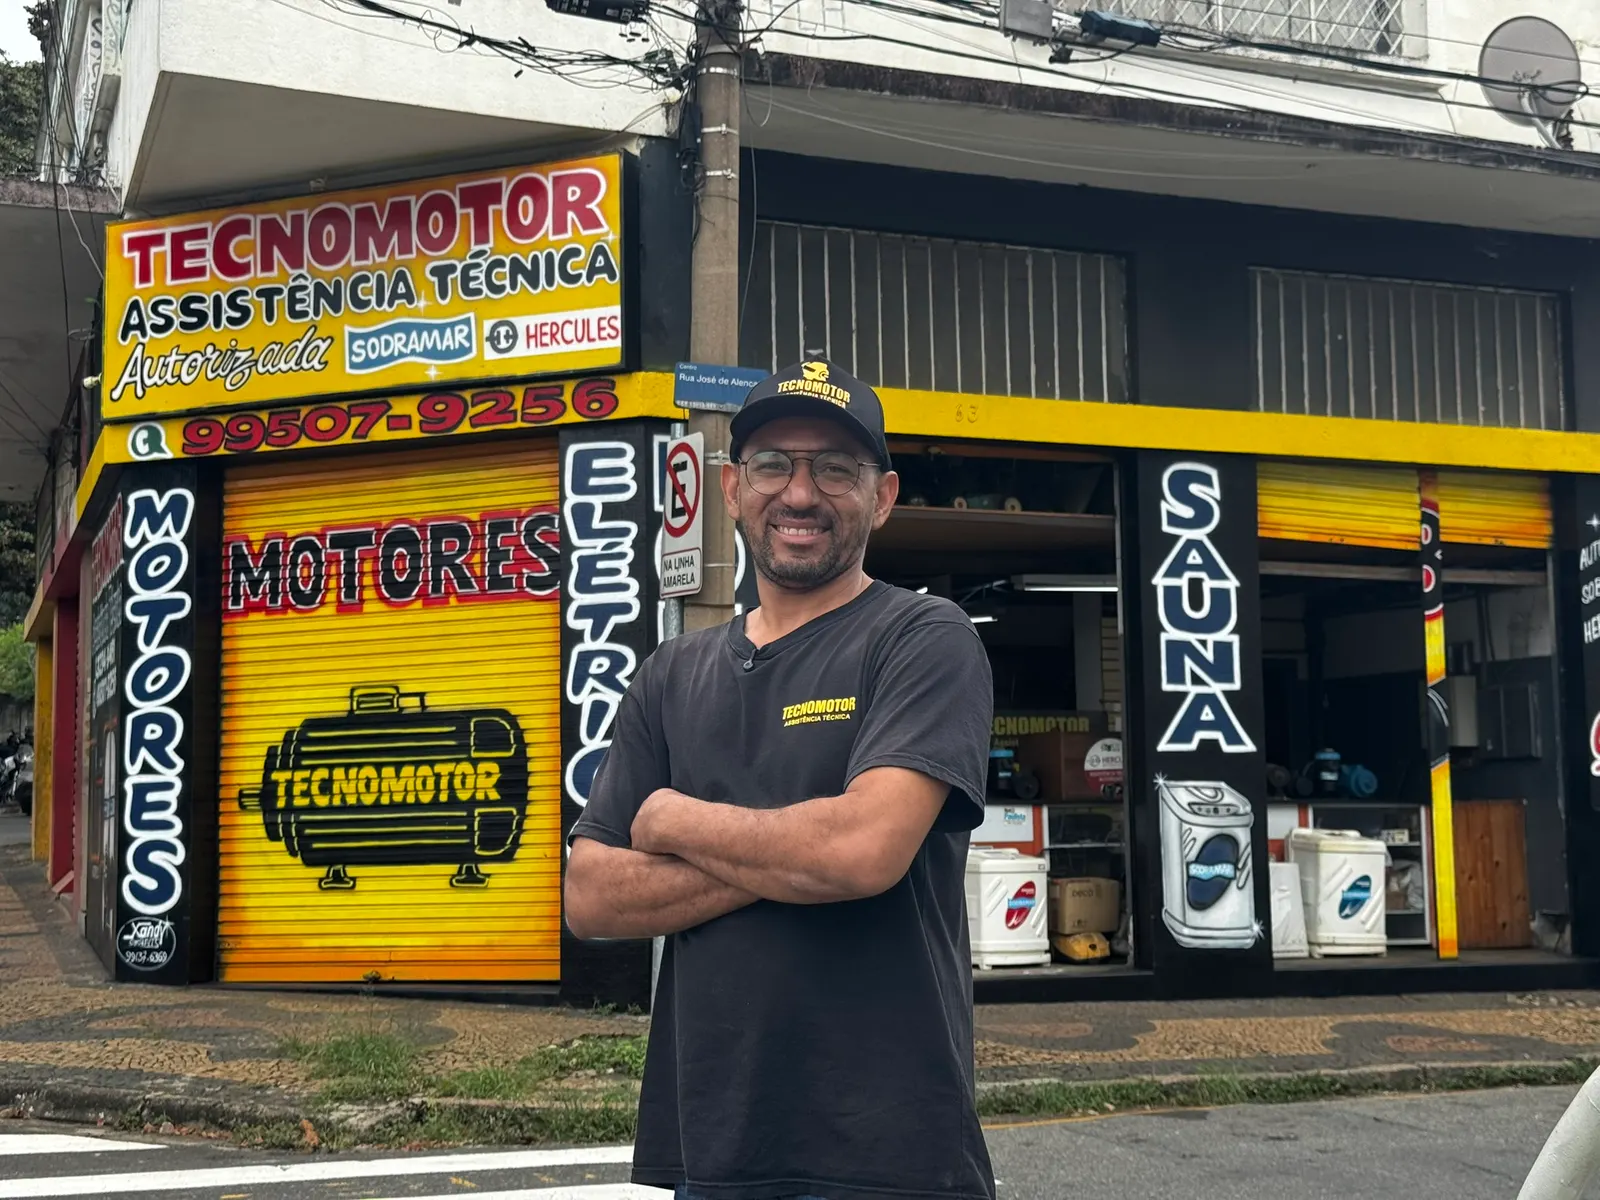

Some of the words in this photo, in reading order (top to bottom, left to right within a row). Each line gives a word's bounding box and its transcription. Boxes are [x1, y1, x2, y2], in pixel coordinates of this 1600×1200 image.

[121, 168, 609, 289] TECNOMOTOR
[118, 267, 418, 345] ASSISTÊNCIA
[429, 242, 619, 305] TÉCNICA
[351, 323, 471, 361] SODRAMAR
[525, 315, 620, 349] HERCULES
[110, 325, 333, 401] Autorizada
[679, 363, 698, 371] Centro
[679, 373, 695, 382] Rua
[696, 375, 716, 384] José
[718, 377, 729, 385] de
[730, 378, 759, 388] Alenca
[777, 379, 851, 404] TECNOMOTOR
[182, 377, 620, 456] 99507-9256
[225, 508, 560, 615] MOTORES
[663, 560, 674, 573] NA
[675, 555, 695, 572] LINHA
[663, 573, 695, 588] AMARELA
[1151, 461, 1257, 753] SAUNA
[121, 487, 195, 915] MOTORES
[782, 696, 856, 720] TECNOMOTOR
[822, 713, 851, 721] TÉCNICA
[271, 761, 502, 809] TECNOMOTOR
